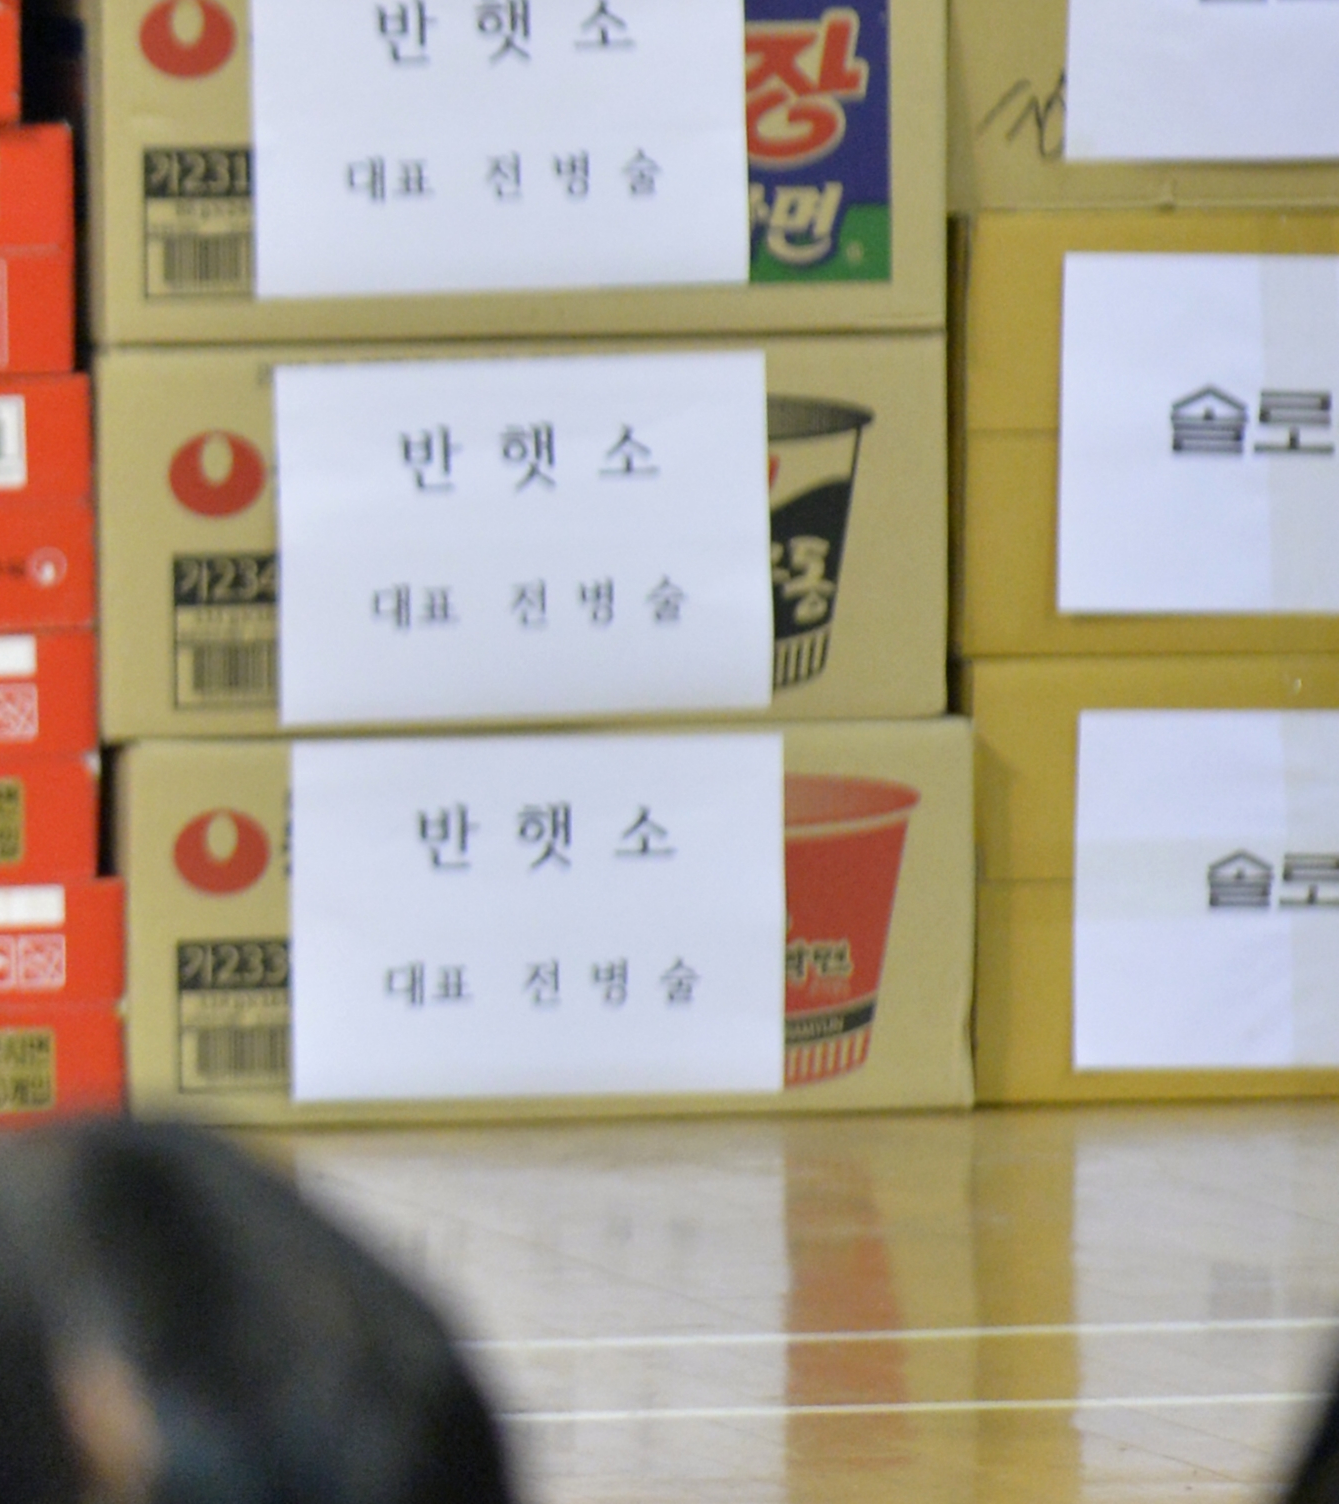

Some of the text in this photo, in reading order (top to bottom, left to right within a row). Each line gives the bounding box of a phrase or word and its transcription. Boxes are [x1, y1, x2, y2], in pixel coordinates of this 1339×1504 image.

[344, 155, 431, 204] 대표
[370, 582, 456, 632] 대표
[383, 960, 471, 1009] 대표
